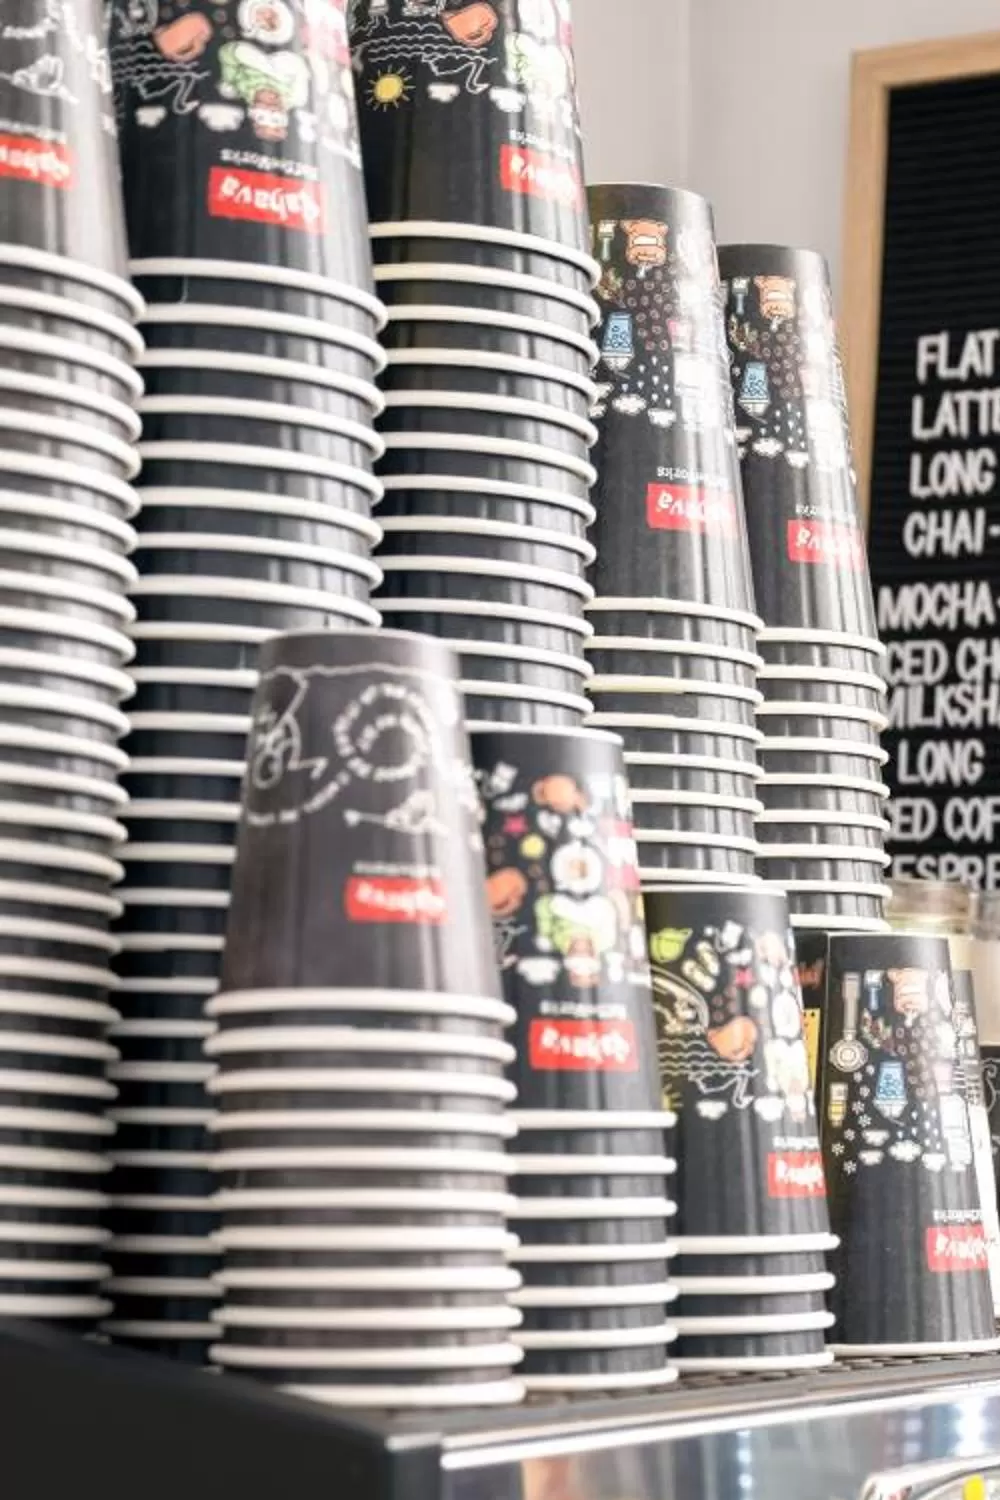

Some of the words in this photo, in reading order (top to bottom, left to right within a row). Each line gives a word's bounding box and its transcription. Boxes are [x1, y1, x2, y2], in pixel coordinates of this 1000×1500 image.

[917, 330, 1000, 382] FLAT
[910, 448, 996, 498] LONG
[898, 739, 984, 785] LONG
